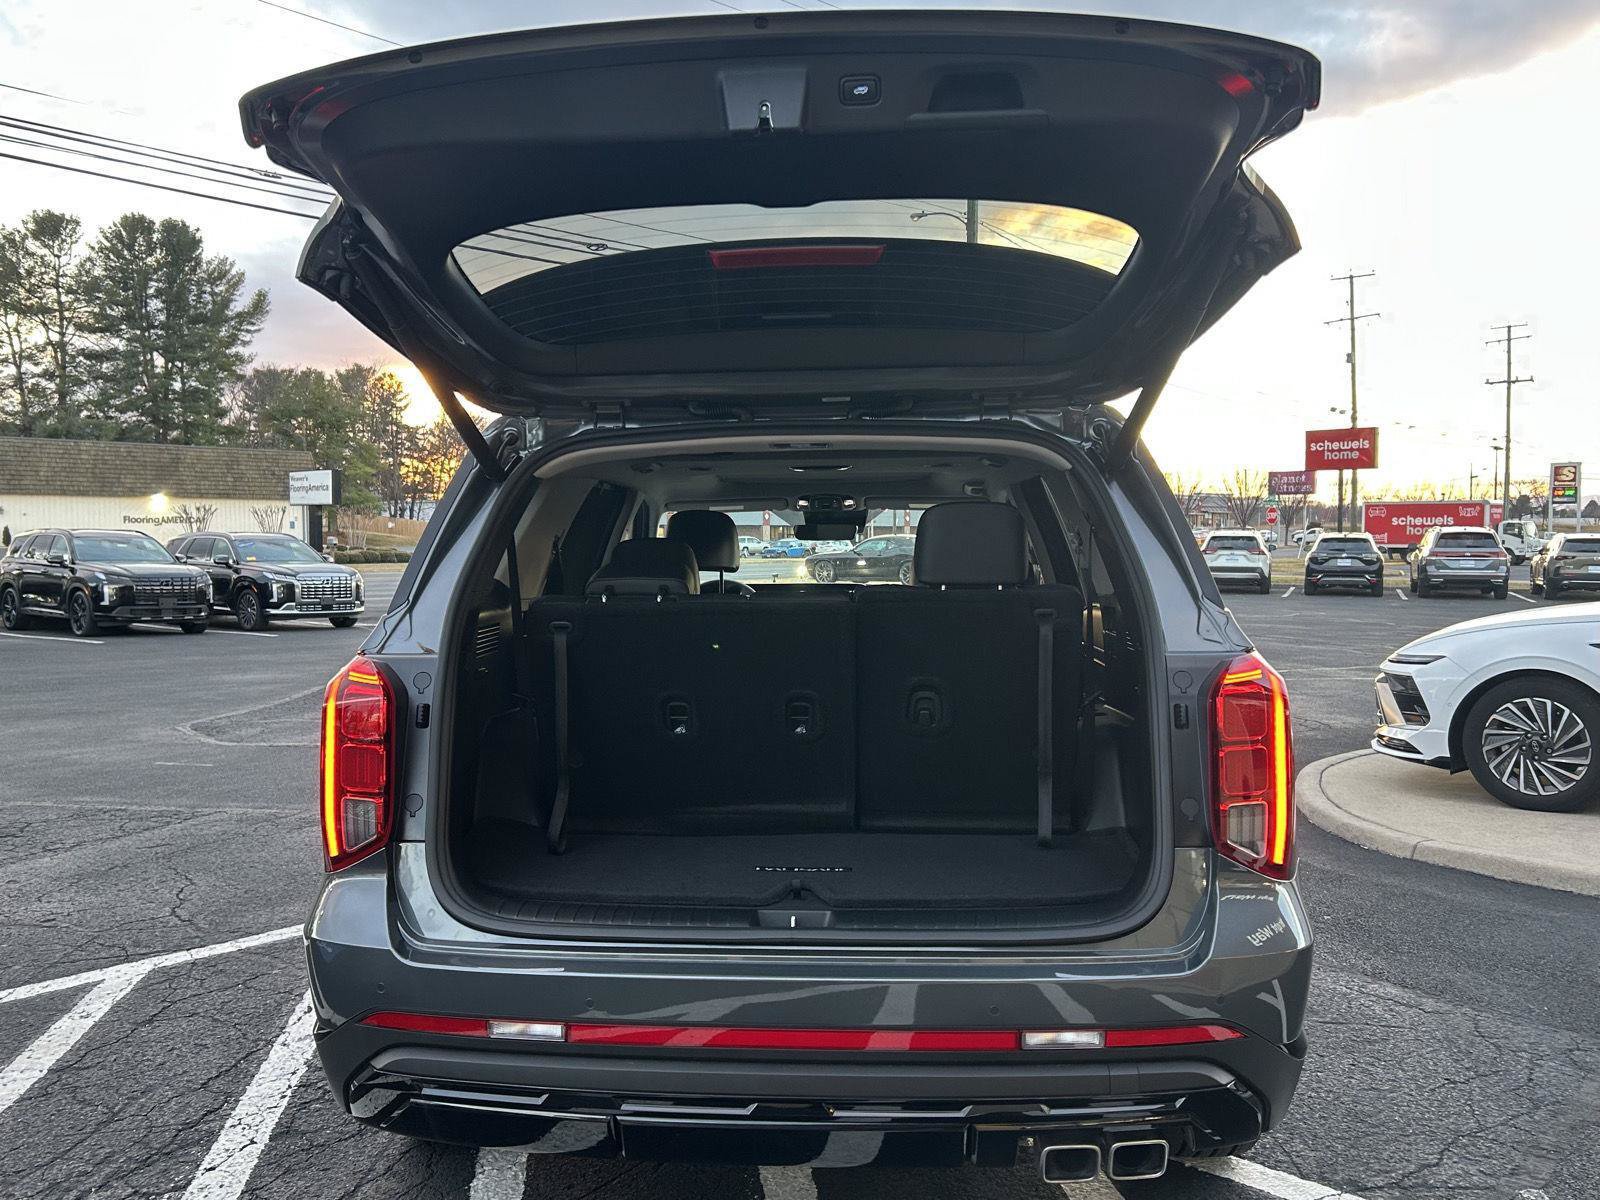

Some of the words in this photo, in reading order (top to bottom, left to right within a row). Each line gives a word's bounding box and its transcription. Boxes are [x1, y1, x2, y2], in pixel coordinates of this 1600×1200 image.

[1310, 439, 1370, 451] schewels
[1324, 450, 1360, 460] home
[1391, 514, 1454, 526] schewels
[1406, 525, 1427, 536] ho
